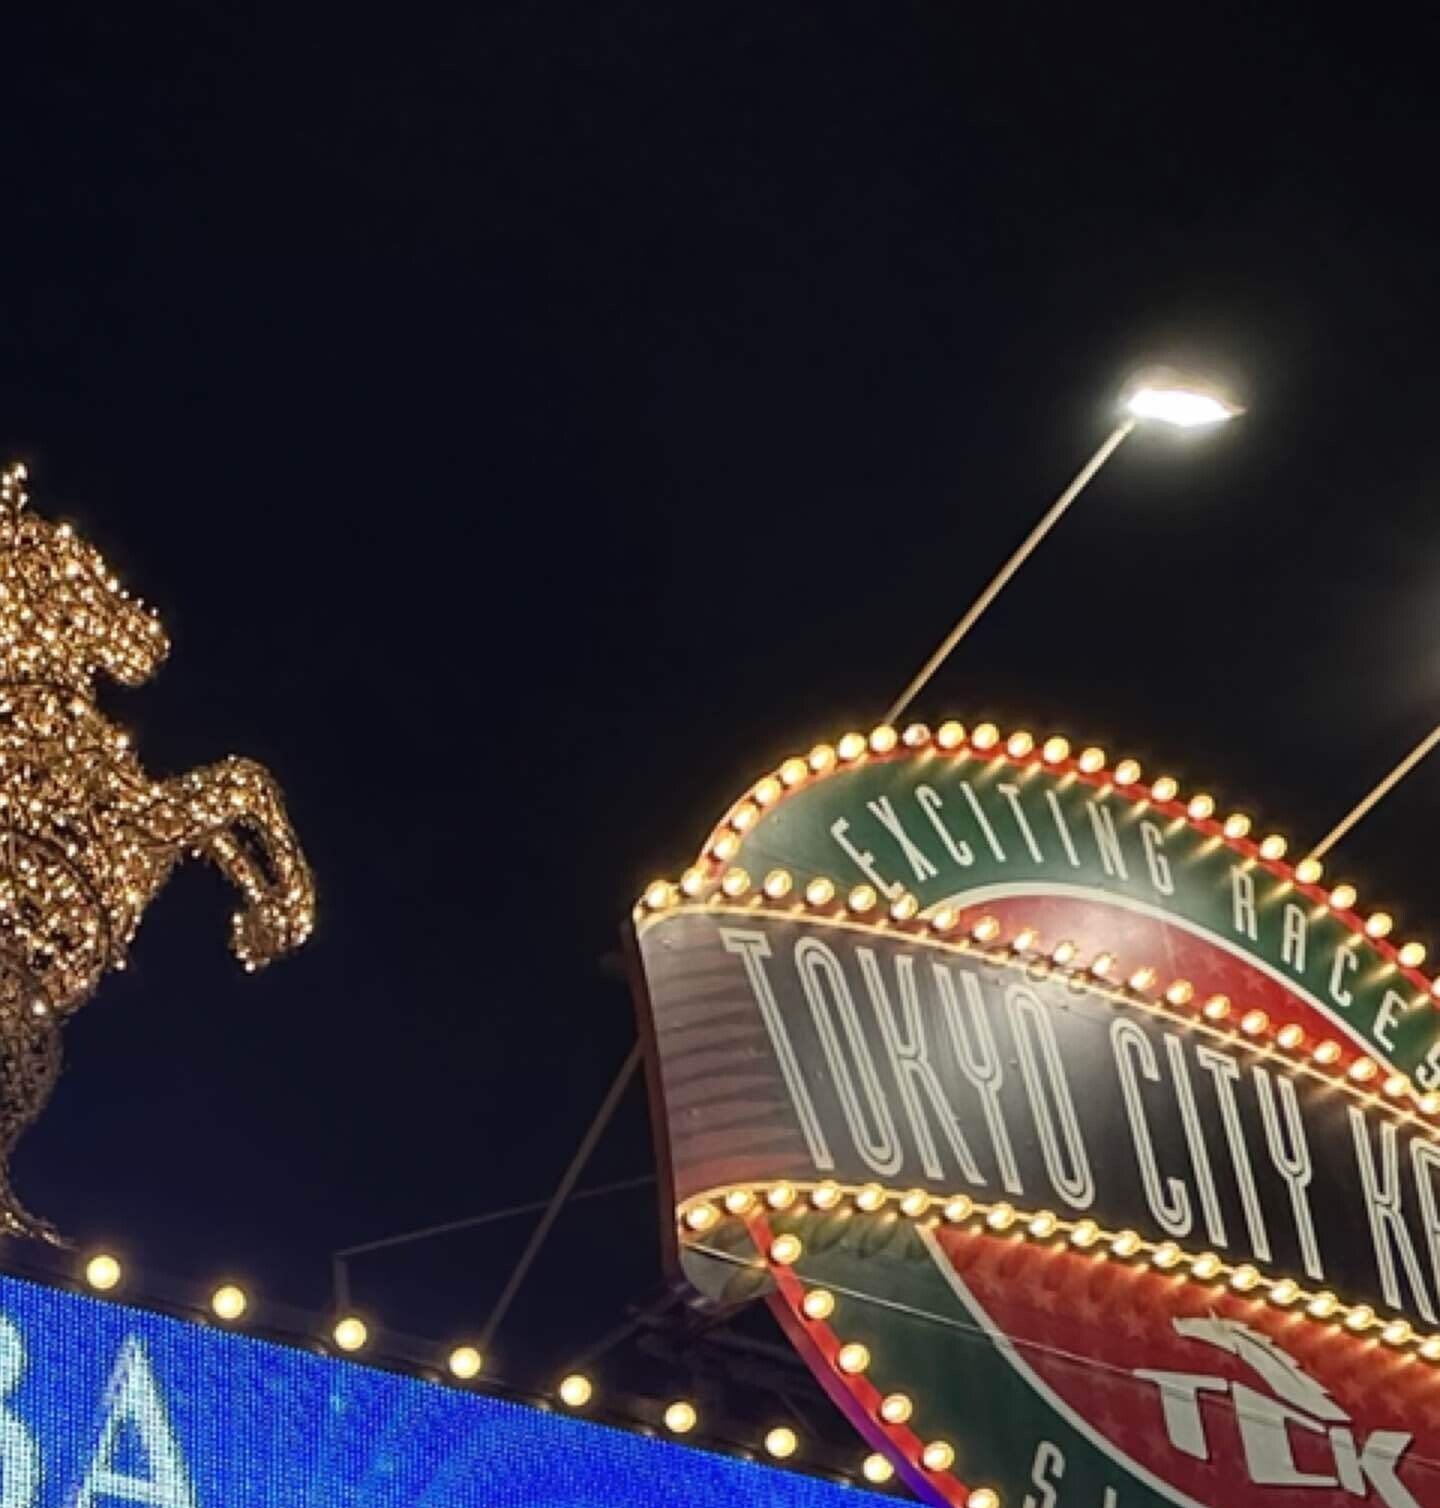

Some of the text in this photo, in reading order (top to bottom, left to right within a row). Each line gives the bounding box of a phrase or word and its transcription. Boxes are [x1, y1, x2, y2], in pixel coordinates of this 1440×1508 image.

[830, 781, 1175, 901] EXCITING
[720, 927, 1096, 1210] TOKYO
[1110, 1017, 1324, 1282] CITY
